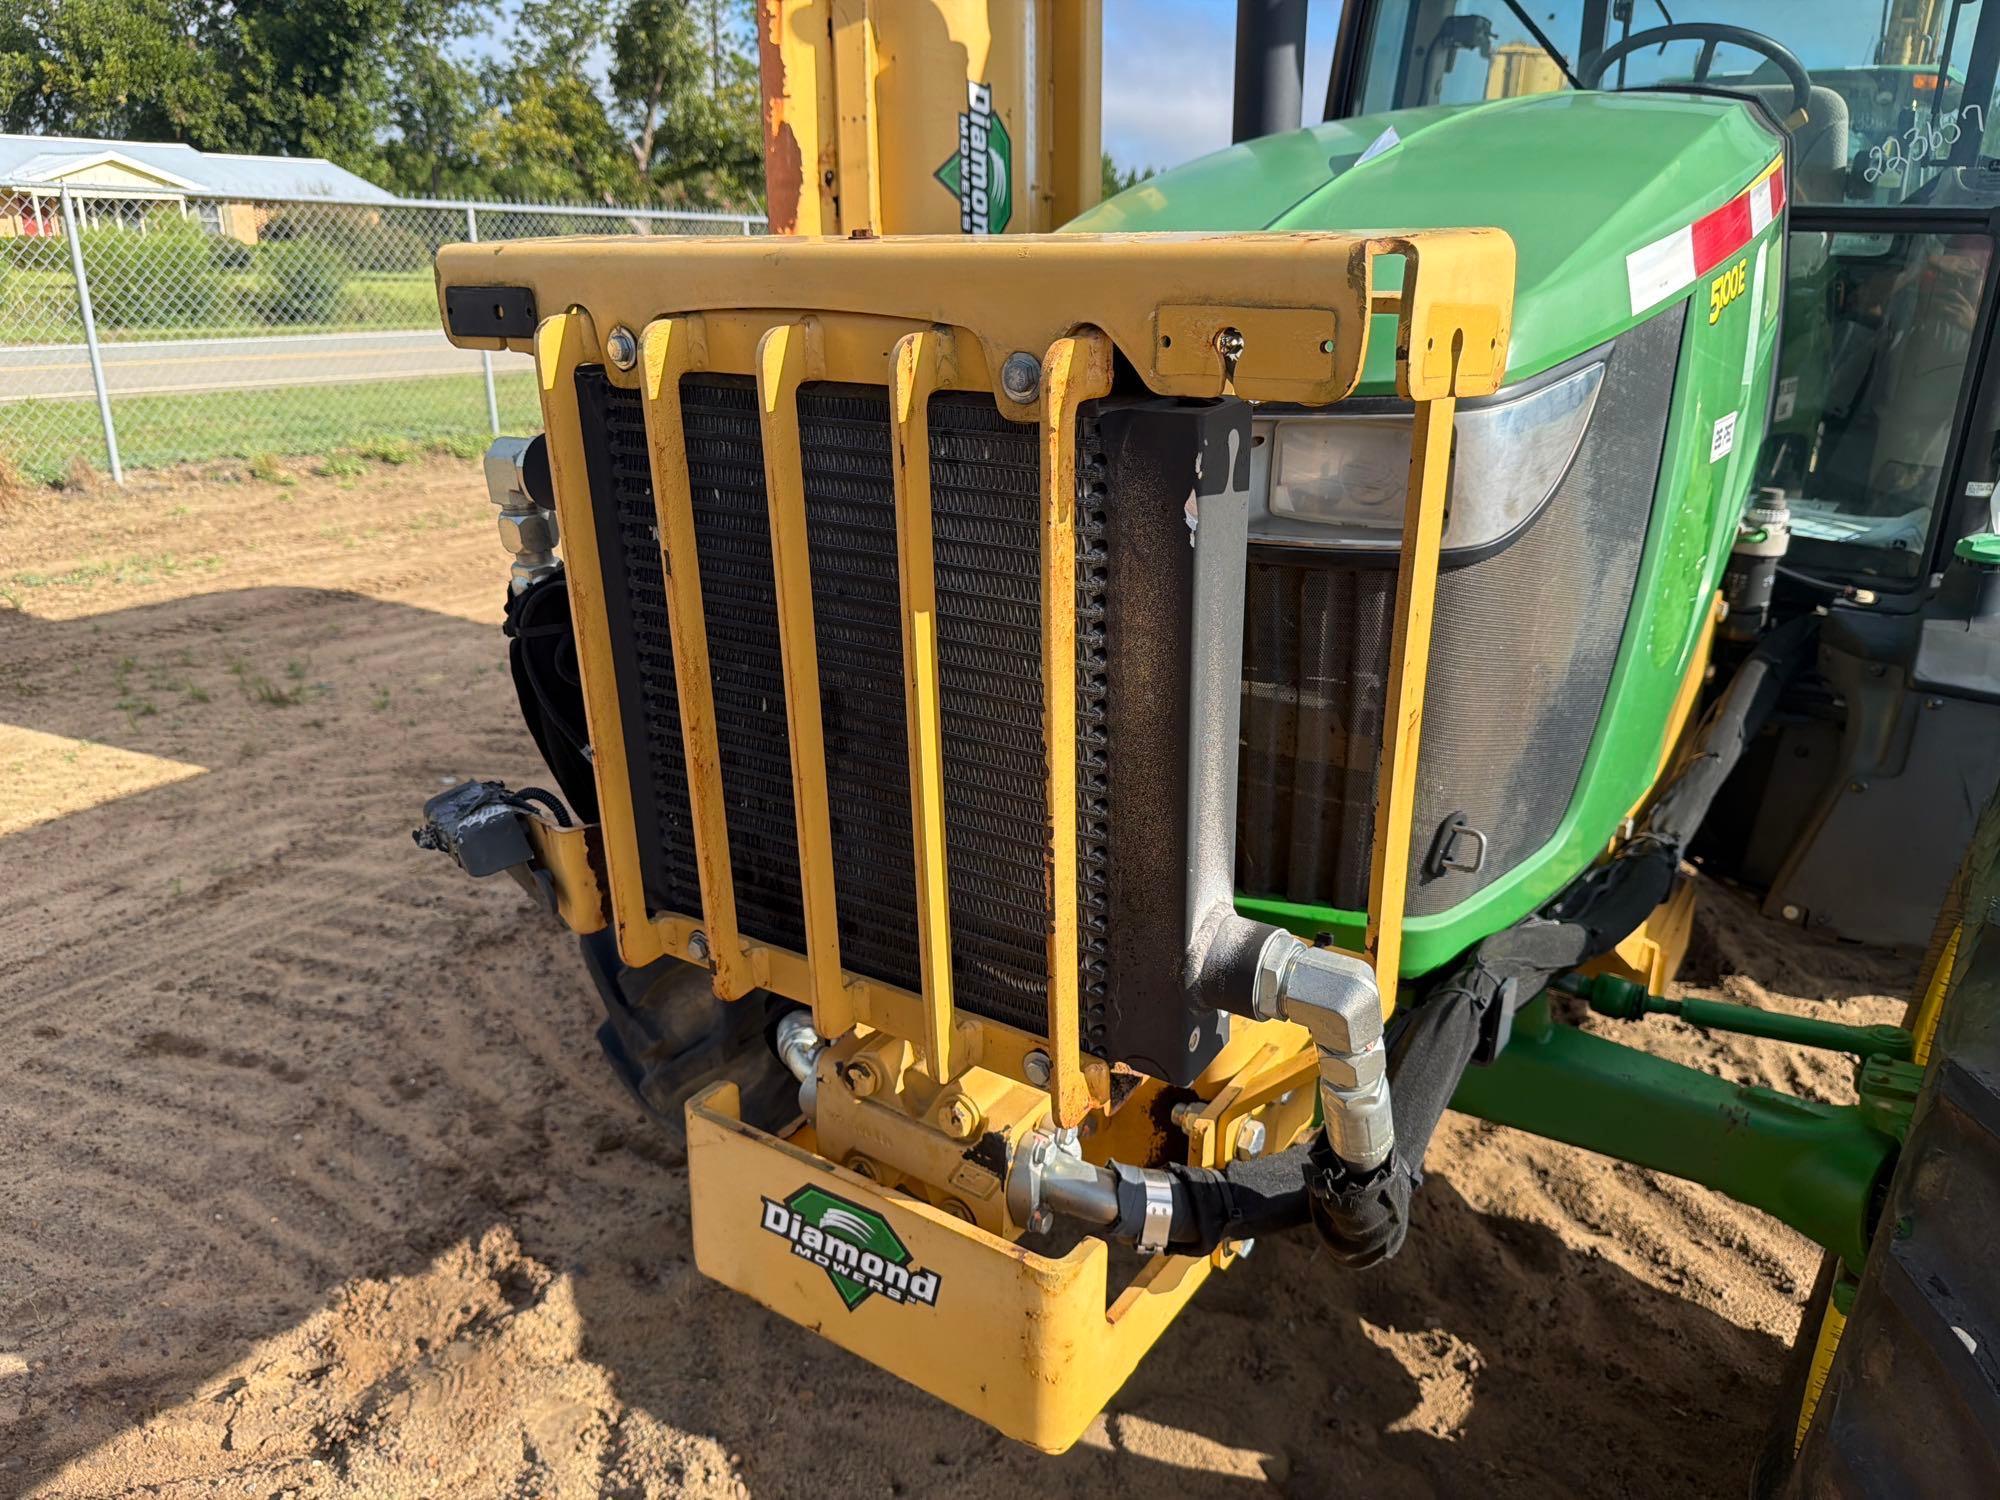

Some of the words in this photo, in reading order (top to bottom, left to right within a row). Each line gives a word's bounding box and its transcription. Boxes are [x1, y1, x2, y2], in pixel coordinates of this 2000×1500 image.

[960, 116, 971, 230] MOWERS
[968, 81, 991, 234] Diamon
[1709, 258, 1747, 324] 5100E
[763, 1200, 938, 1303] Diamond
[794, 1244, 903, 1301] MOWERS
